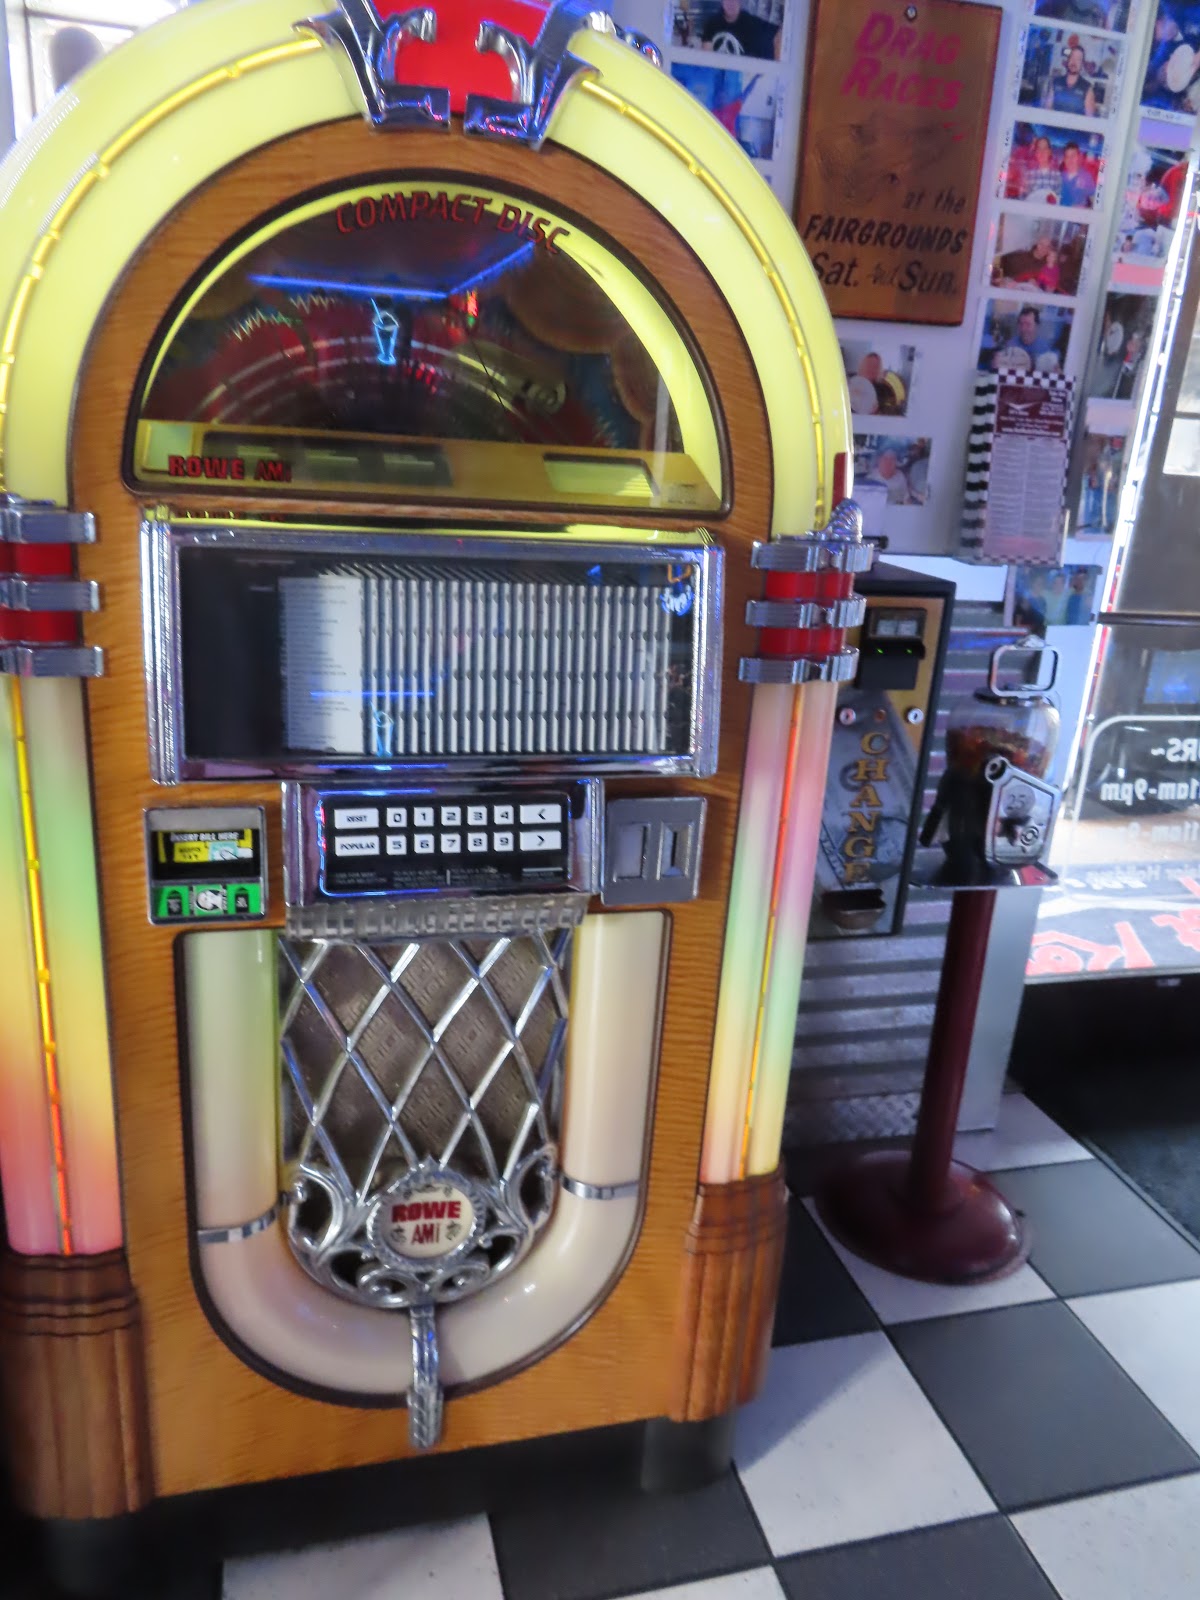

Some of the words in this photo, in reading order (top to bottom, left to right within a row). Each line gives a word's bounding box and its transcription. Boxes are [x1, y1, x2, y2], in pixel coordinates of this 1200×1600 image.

[841, 56, 966, 111] RACES
[934, 186, 966, 215] the
[336, 191, 492, 233] COMPACT
[497, 203, 570, 254] DISC
[803, 214, 968, 255] FAIRGROUNDS
[811, 251, 860, 288] Sat.
[168, 455, 245, 481] ROWE
[393, 813, 402, 823] 0
[420, 812, 427, 821] 1
[446, 811, 456, 821] 2
[473, 811, 483, 821] 3
[500, 810, 509, 820] 4
[844, 731, 891, 884] CHANGE
[392, 840, 402, 850] 5
[420, 839, 430, 849] 6
[447, 838, 456, 848] 7
[473, 838, 483, 847] 8
[500, 837, 509, 846] 9
[392, 1201, 462, 1223] ROWE
